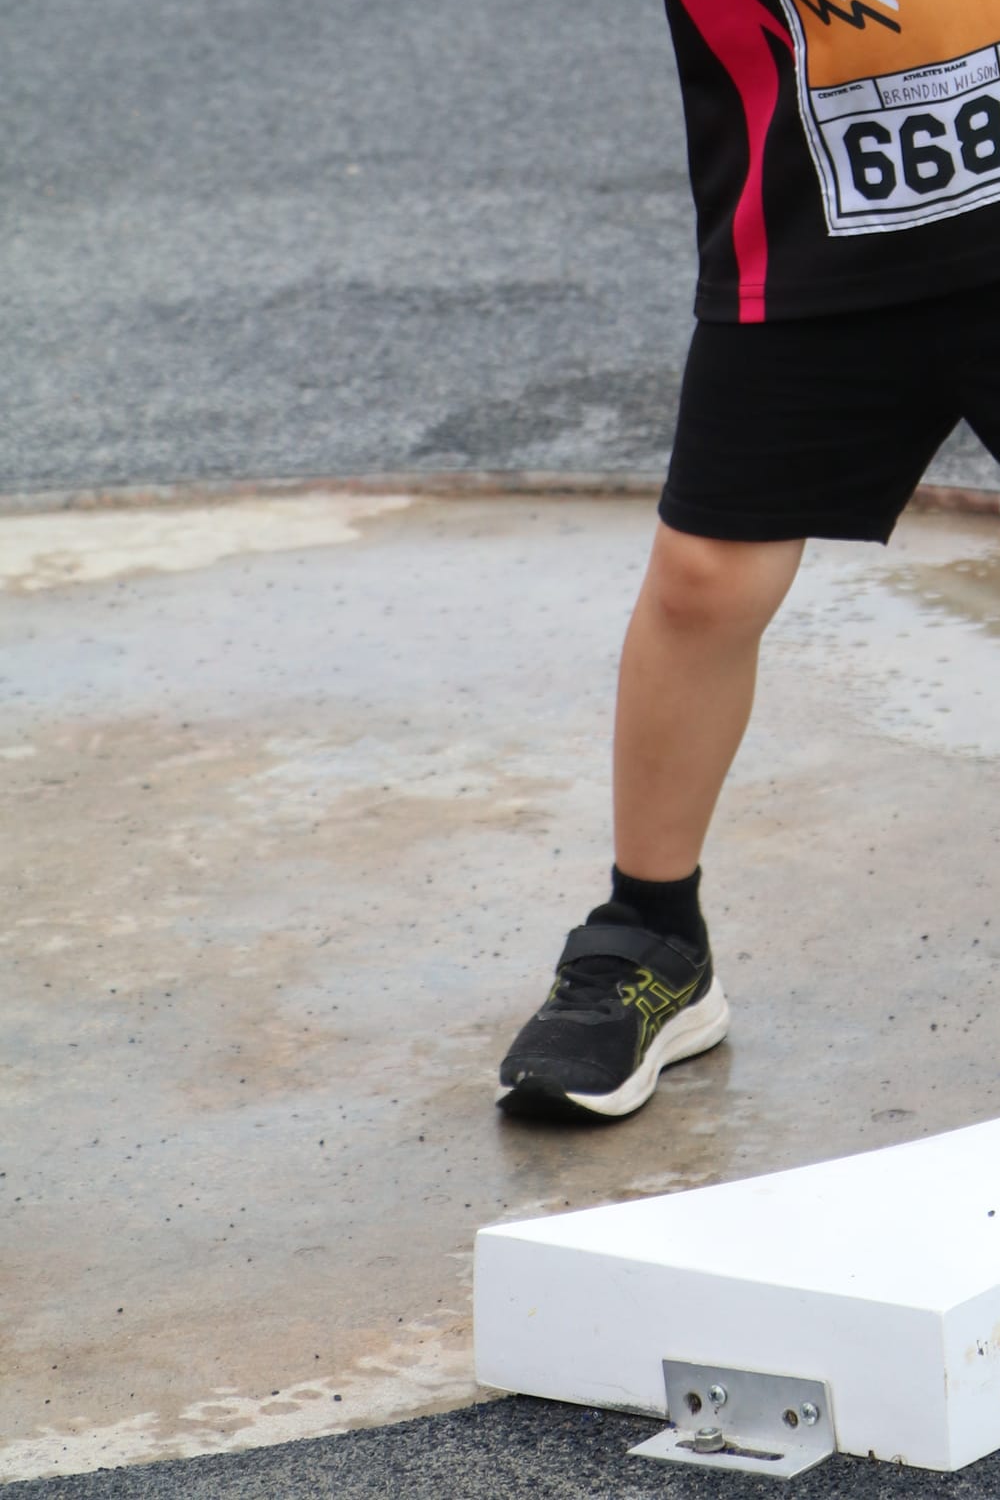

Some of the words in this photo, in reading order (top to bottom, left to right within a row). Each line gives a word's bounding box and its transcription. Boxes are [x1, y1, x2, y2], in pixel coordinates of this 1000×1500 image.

[944, 60, 968, 74] NAME
[882, 82, 950, 105] BRANDON
[953, 62, 999, 93] WILSON
